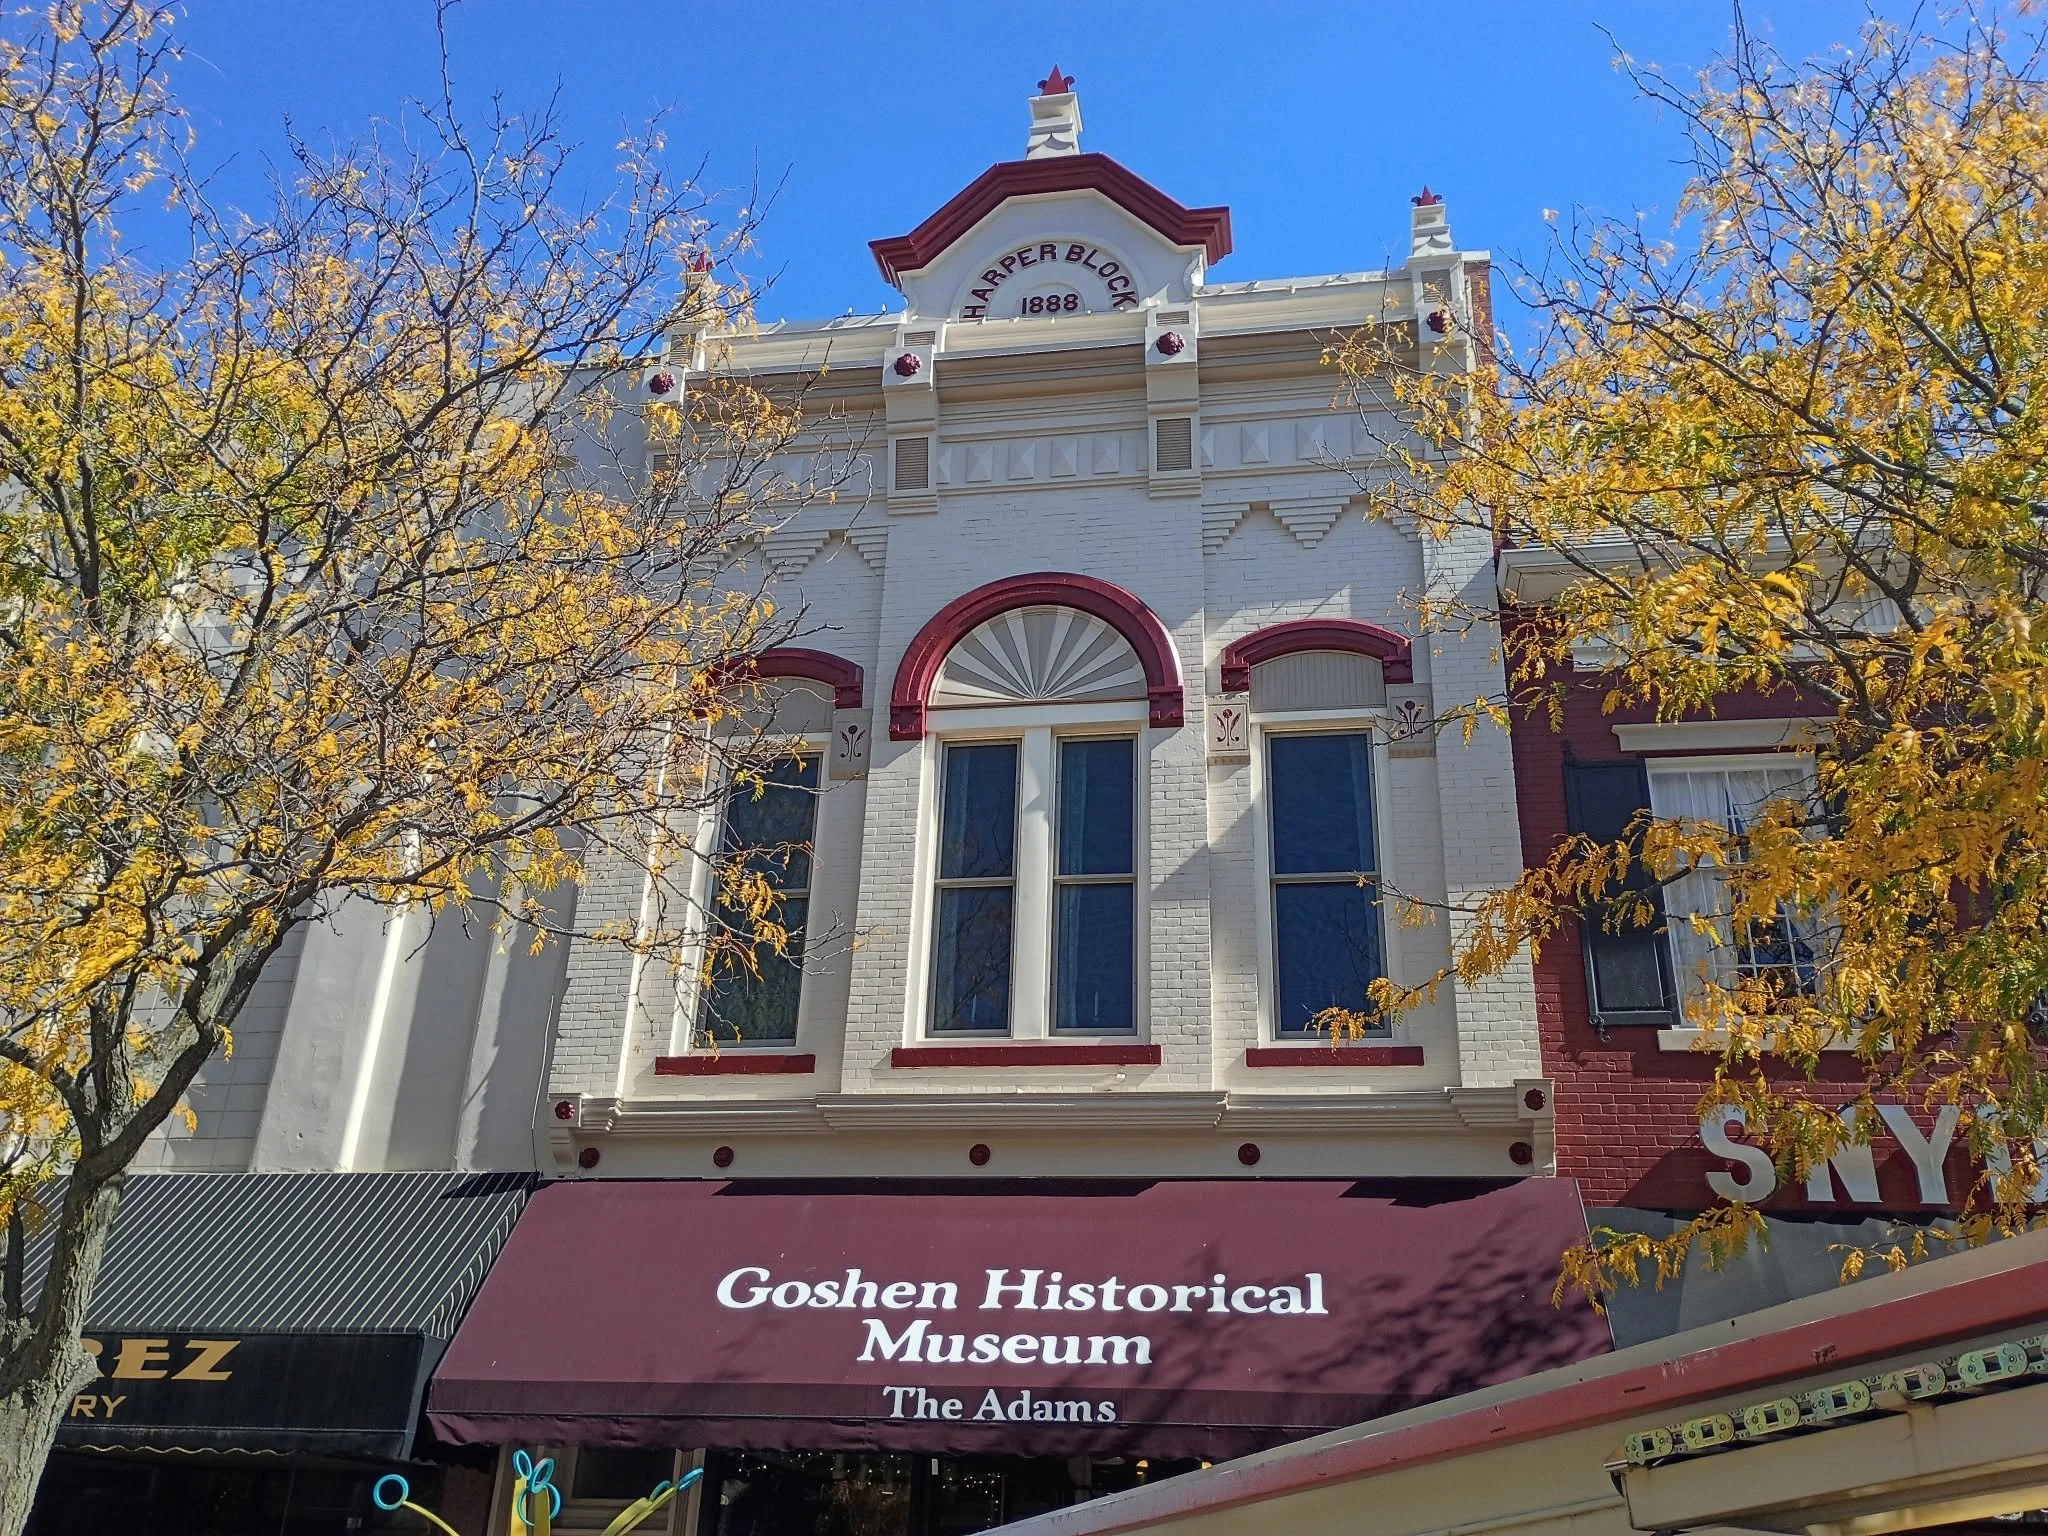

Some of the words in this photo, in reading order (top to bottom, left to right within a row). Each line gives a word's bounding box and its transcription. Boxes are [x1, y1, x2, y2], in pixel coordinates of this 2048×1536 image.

[962, 242, 1058, 319] HARPER
[1064, 243, 1138, 309] BLOCK
[1021, 293, 1079, 316] 1888
[716, 1266, 958, 1310] Goshen
[978, 1268, 1329, 1315] Historical
[856, 1318, 1153, 1365] Museum
[883, 1385, 963, 1420] The
[972, 1388, 1117, 1423] Adams
